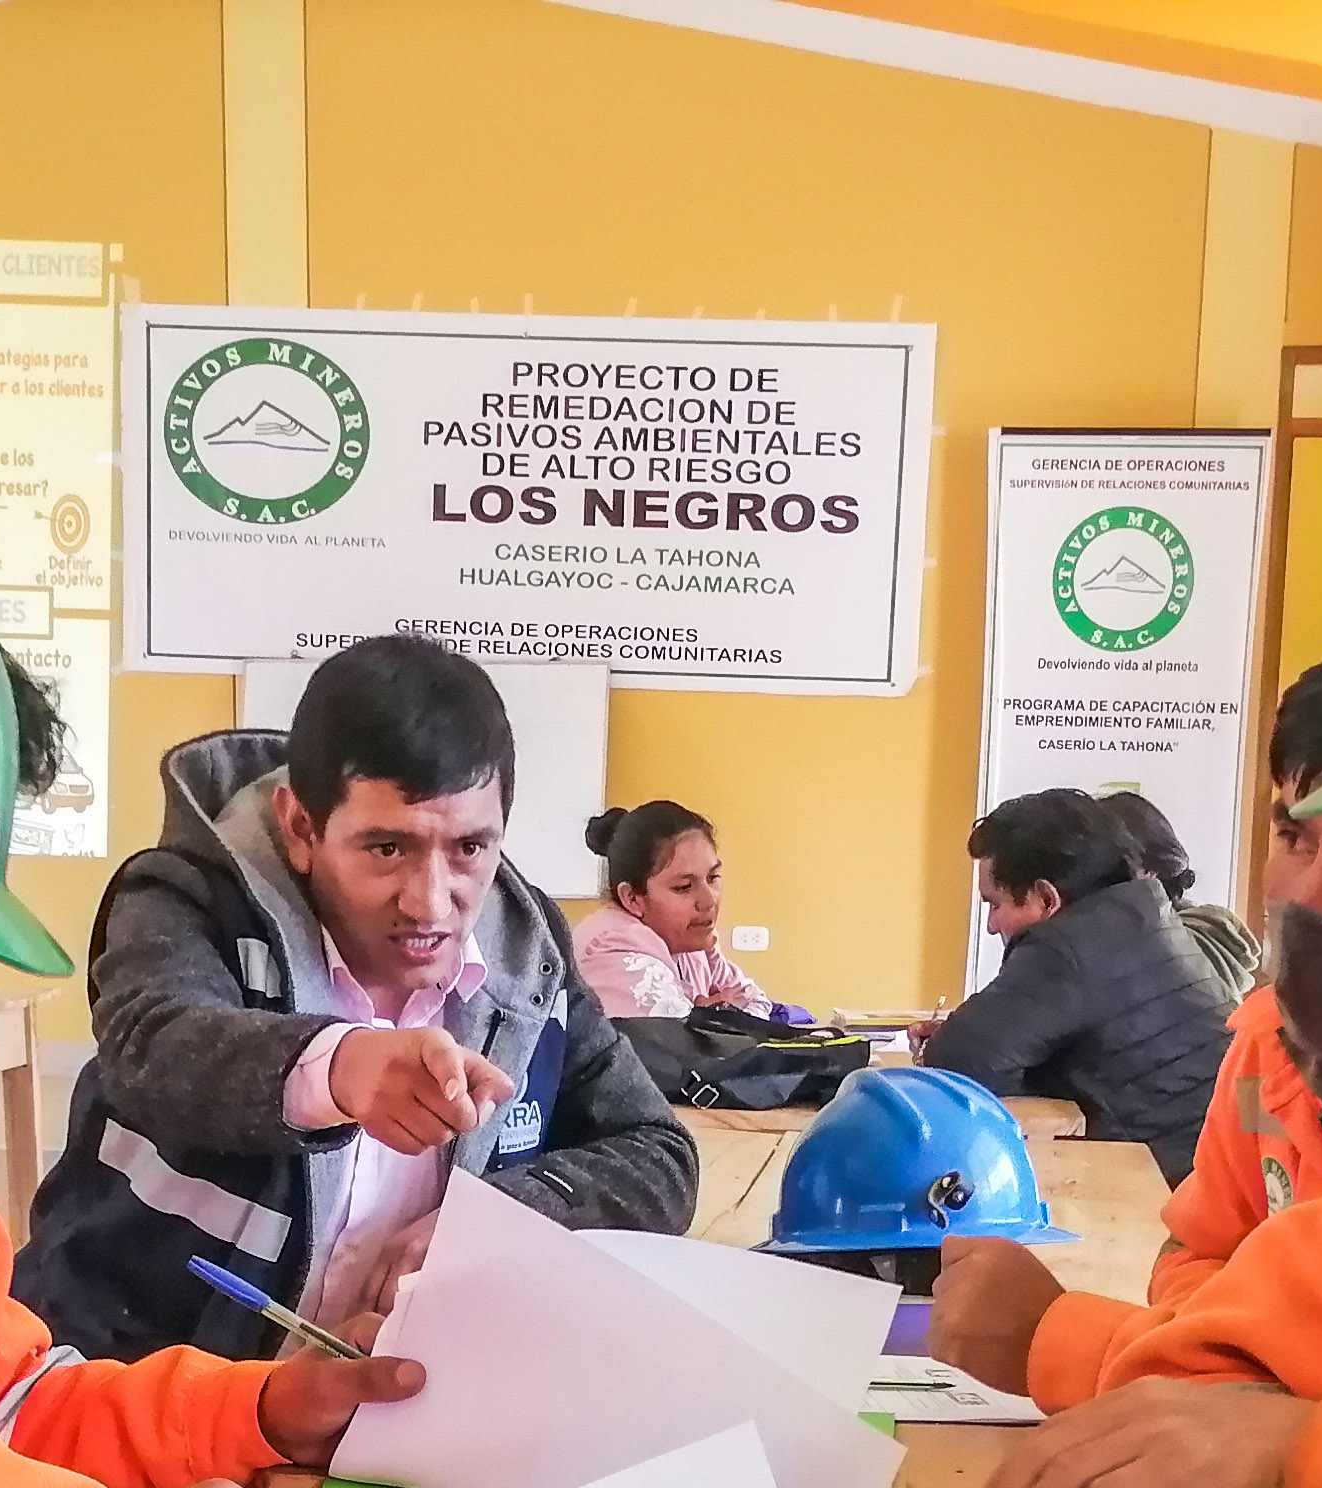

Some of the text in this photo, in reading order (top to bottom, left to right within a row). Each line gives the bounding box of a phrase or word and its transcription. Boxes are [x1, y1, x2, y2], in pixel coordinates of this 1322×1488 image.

[1, 254, 101, 280] CLIENTES
[53, 351, 89, 373] para
[12, 382, 21, 396] a
[24, 379, 46, 397] los
[48, 379, 105, 399] clientes
[511, 361, 780, 394] PROYECTO DE
[169, 342, 363, 480] ACTIVOS MINEROS
[481, 393, 797, 427] REMEDACION DE
[423, 420, 863, 459] PASIVOS AMBIENTALES
[13, 449, 35, 468] los
[481, 452, 792, 486] DE ALTO RIESGO
[1031, 458, 1226, 473] GERENCIA DE OPERACIONES
[1080, 480, 1095, 490] DE
[1097, 480, 1167, 491] RELACIONES
[1168, 480, 1251, 492] COMUNITARIAS
[432, 482, 861, 535] LOS NEGROS
[168, 529, 387, 549] DEVOLVIENDO VIDA AL PLANETA
[48, 556, 93, 572] Definir
[494, 542, 762, 570] CASERIO LA TAHONA
[1058, 511, 1189, 616] ACTIVOS MINEROS
[35, 571, 104, 588] el objetivo
[458, 567, 615, 591] HUALGAYOC
[634, 573, 796, 597] CAJAMARCA
[394, 618, 700, 644] GERENCIA DE OPERACIONES
[478, 639, 614, 661] RELACIONES
[619, 643, 783, 666] COMUNITARIAS
[1037, 657, 1199, 674] Devolviendo vida al planeta
[1088, 700, 1109, 713] DE
[1111, 698, 1216, 715] CAPACITACIÓN
[1219, 702, 1240, 715] EN
[1014, 715, 1216, 732] EMPRENDIMIENTO FAMILIAR,
[1037, 737, 1096, 751] CASERÍO
[1099, 740, 1117, 751] LA
